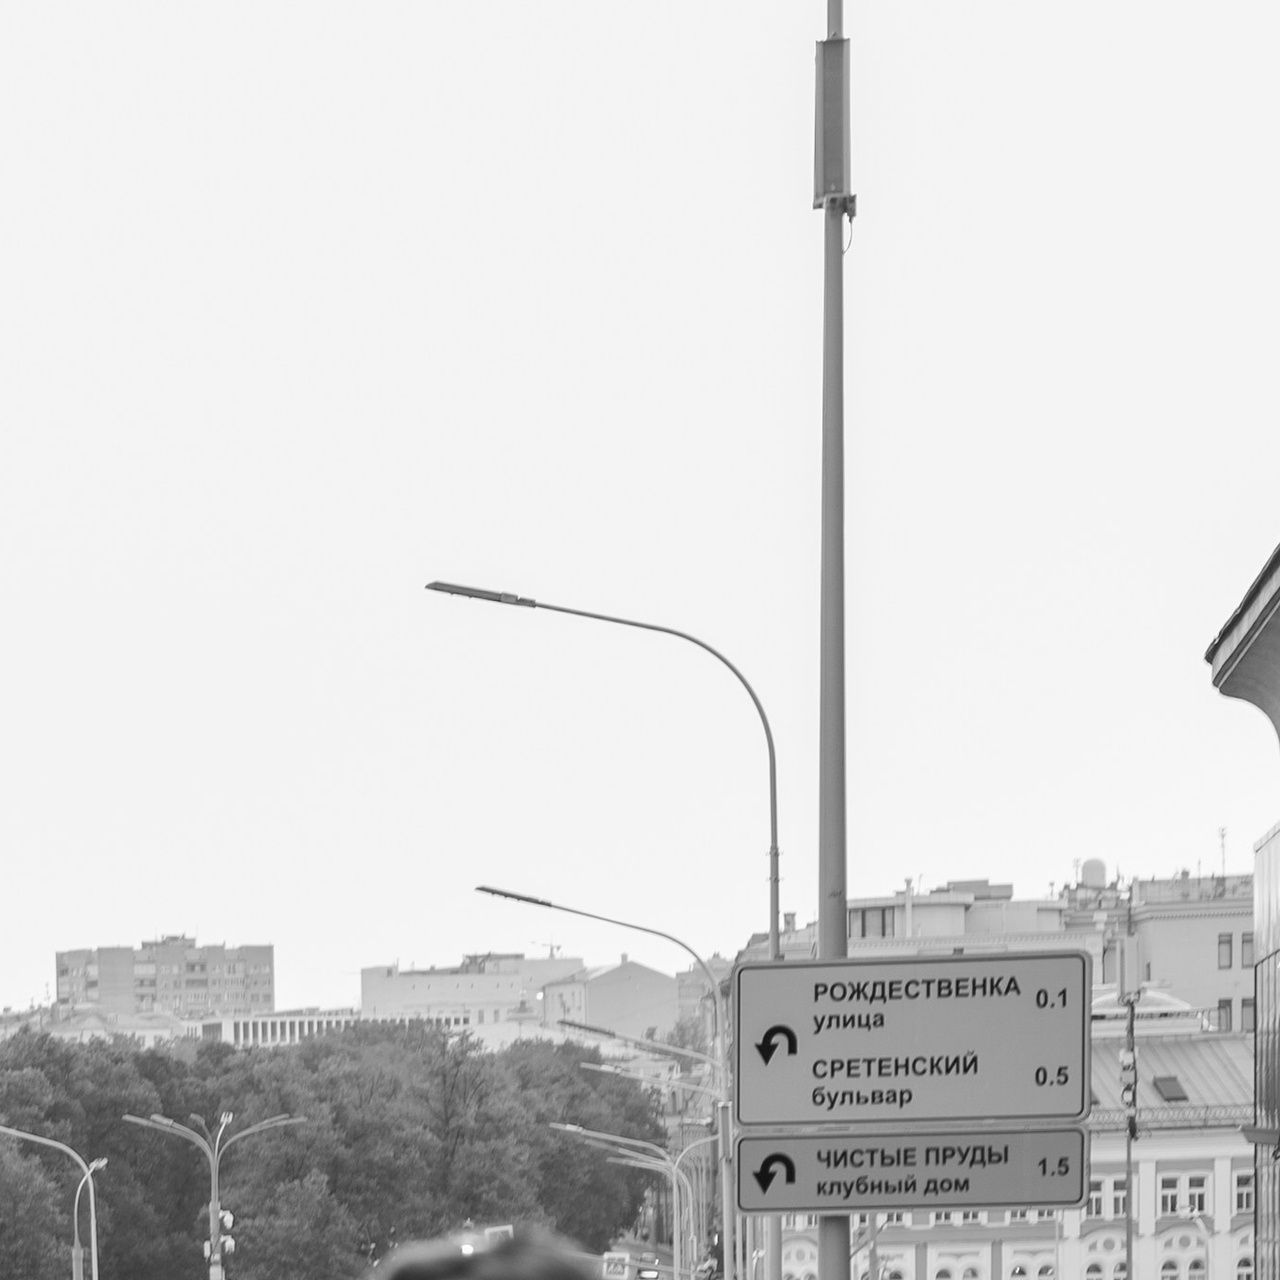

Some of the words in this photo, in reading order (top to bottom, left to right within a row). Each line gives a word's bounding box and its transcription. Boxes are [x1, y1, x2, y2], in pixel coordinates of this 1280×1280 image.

[814, 976, 1021, 1004] РОЖДЕСТВЕНКА
[1035, 988, 1067, 1009] 0.1
[813, 1012, 885, 1034] улица
[812, 1051, 978, 1079] СРЕТЕНСКИЙ
[1034, 1066, 1069, 1086] 0.5
[811, 1086, 913, 1110] бульвар
[816, 1147, 917, 1169] ЧИСТЫЕ
[925, 1145, 1009, 1168] ПРУДЫ
[1037, 1157, 1070, 1177] 1.5
[816, 1174, 917, 1200] клубный
[923, 1178, 970, 1196] дом
